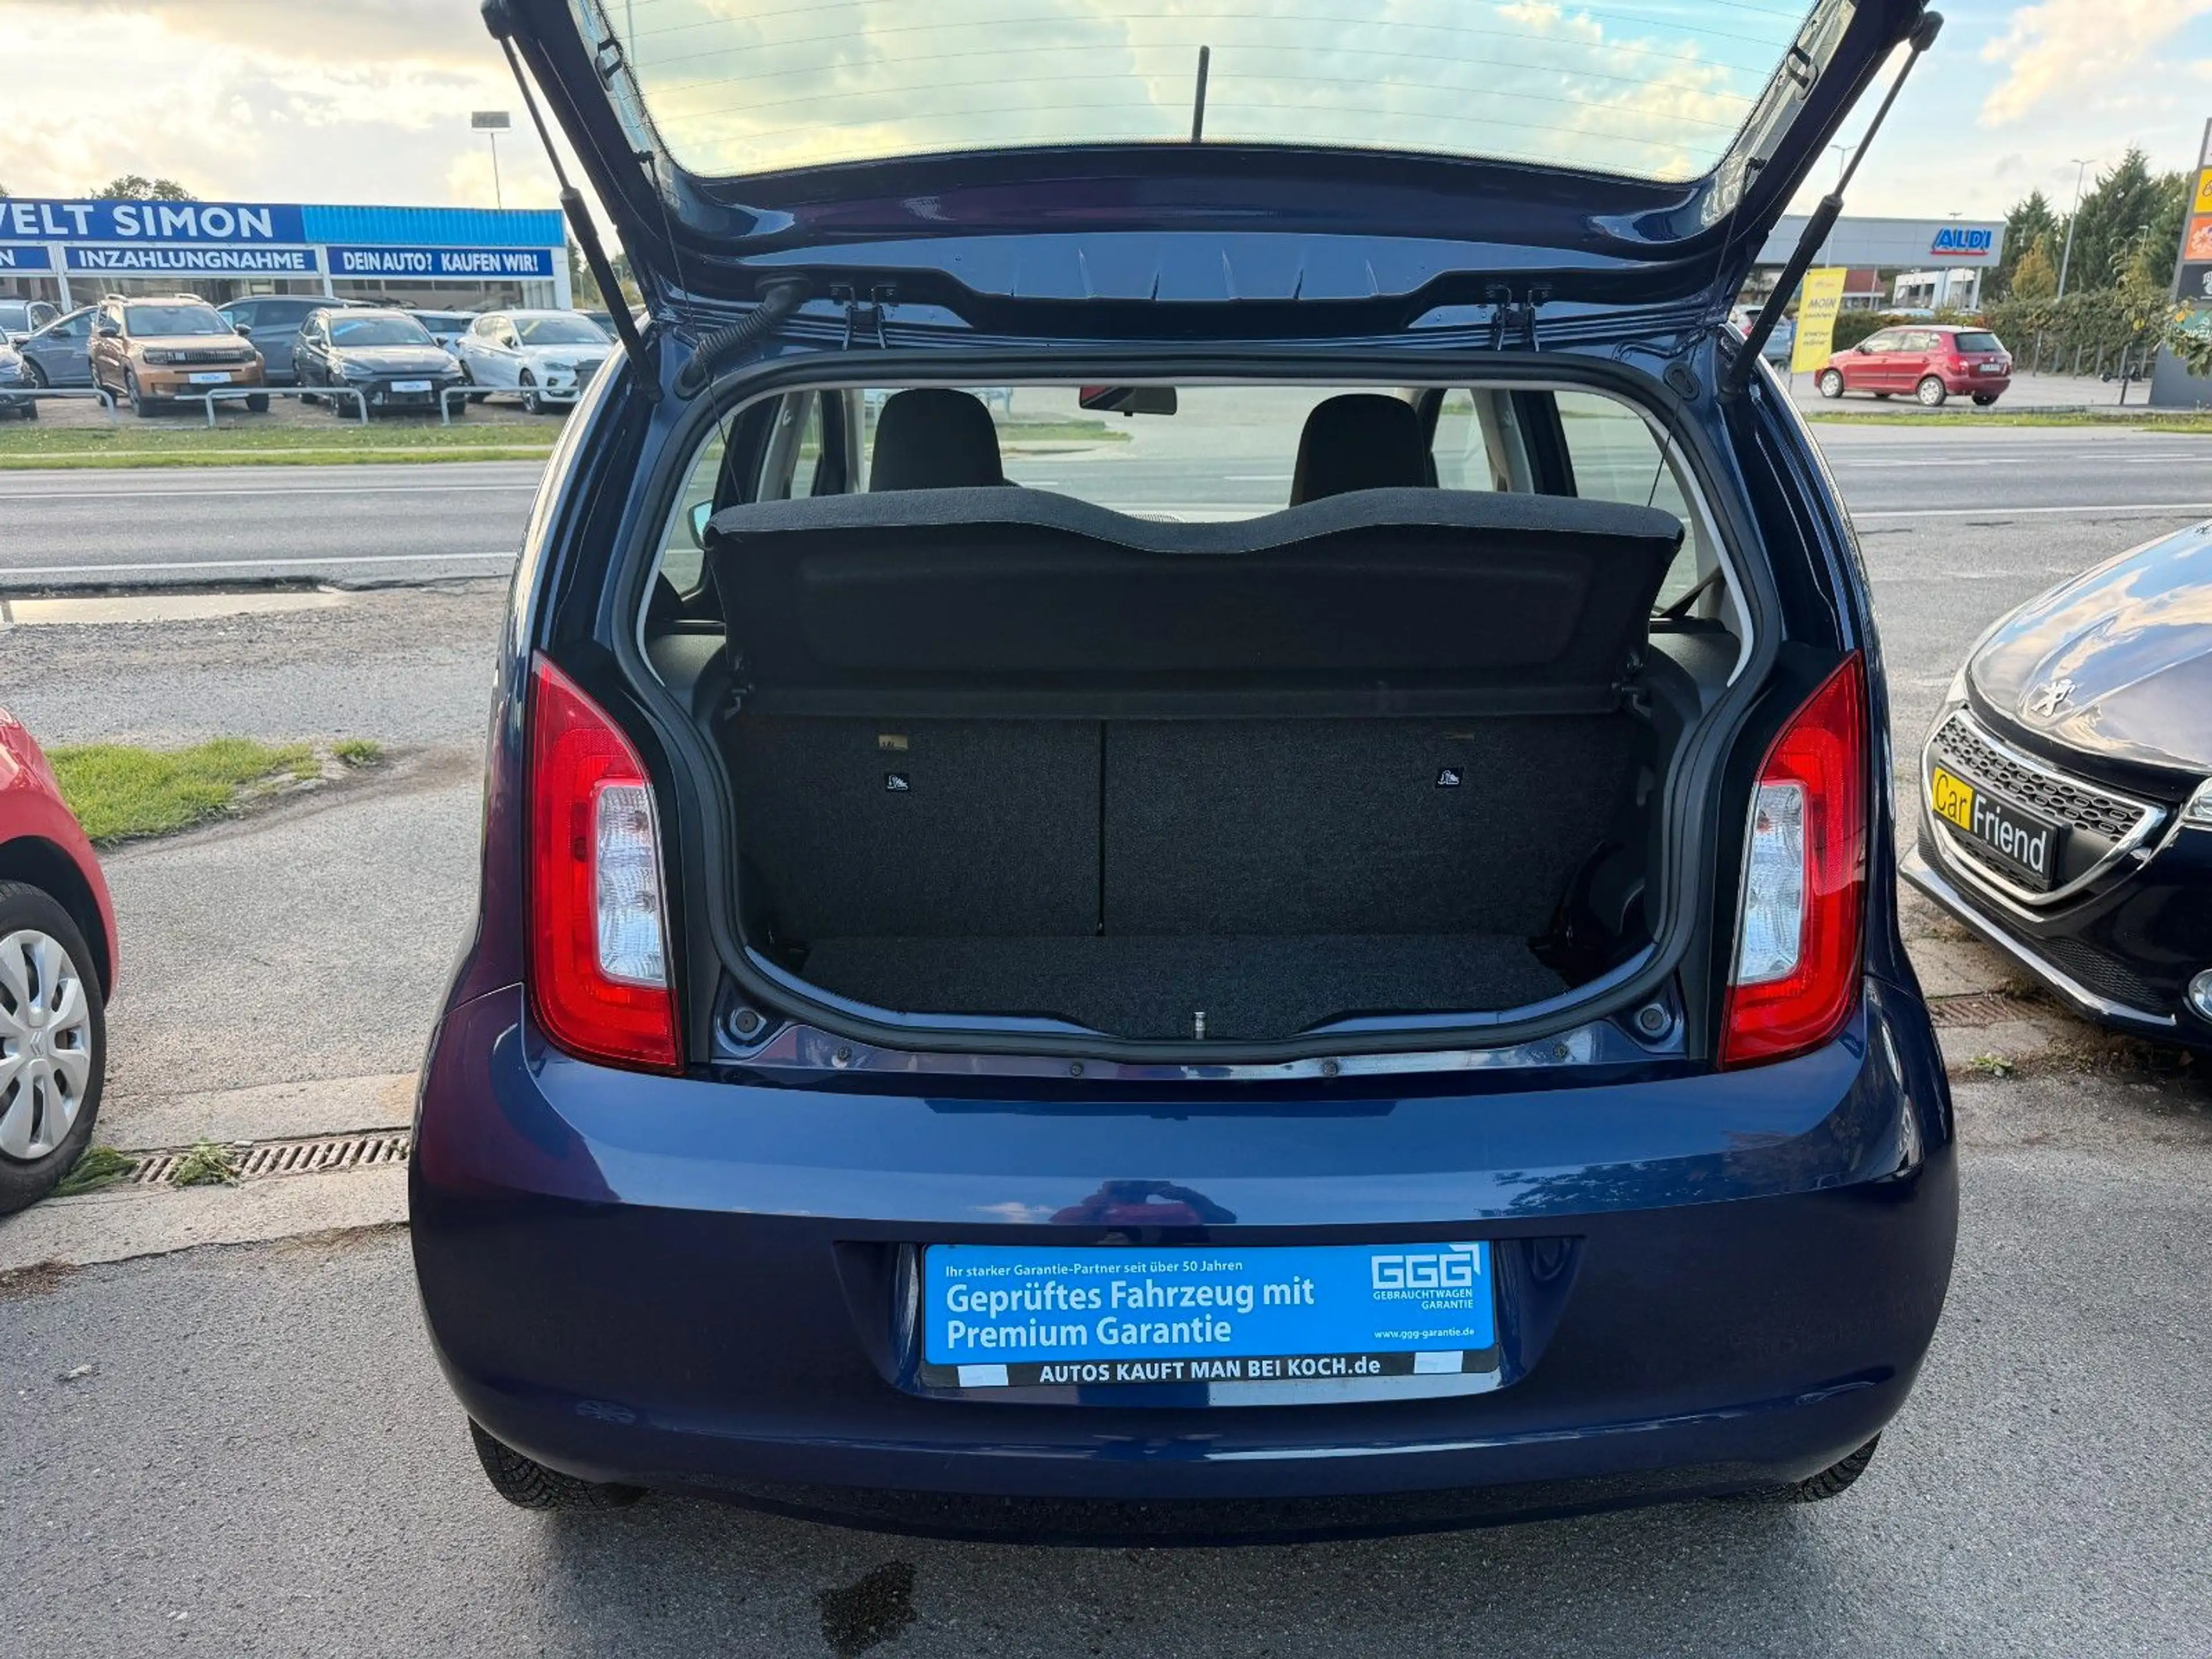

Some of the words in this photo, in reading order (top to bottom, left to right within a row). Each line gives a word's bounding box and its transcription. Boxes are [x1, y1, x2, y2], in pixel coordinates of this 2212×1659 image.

[0, 203, 94, 234] ELT
[113, 205, 273, 237] SIMON
[1934, 229, 1992, 248] ALDI
[78, 250, 305, 269] INZAHLUNGNAHME
[343, 252, 382, 271] DEIN
[382, 252, 432, 271] AUTO?
[441, 253, 502, 271] KAUFEN
[503, 253, 539, 271] WIR!
[1937, 774, 1968, 824] Car
[1974, 794, 2047, 873] Friend
[946, 1266, 964, 1277] Ihr
[966, 1265, 1010, 1277] starker
[1014, 1263, 1120, 1276] Garantie-Partner
[1124, 1262, 1146, 1273] seit
[1150, 1261, 1179, 1273] über
[1183, 1261, 1197, 1272] 50
[1200, 1259, 1243, 1272] Jahren
[1372, 1253, 1472, 1289] GGG
[946, 1280, 1102, 1319] Geprüftes
[1111, 1279, 1253, 1314] Fahrzeug
[1263, 1275, 1314, 1305] mit
[1373, 1289, 1473, 1300] GEBRAUCHTWAGEN
[1421, 1300, 1474, 1310] GARANTIE
[948, 1318, 1088, 1349] Premium
[1096, 1313, 1232, 1345] Garantie
[1374, 1327, 1475, 1339] www.ggg-garantie.de
[1040, 1364, 1110, 1382] AUTOS
[1116, 1362, 1184, 1381] KAUFT
[1191, 1360, 1241, 1378] MAN
[1248, 1359, 1280, 1377] BEI
[1287, 1357, 1381, 1376] KOCH.de
